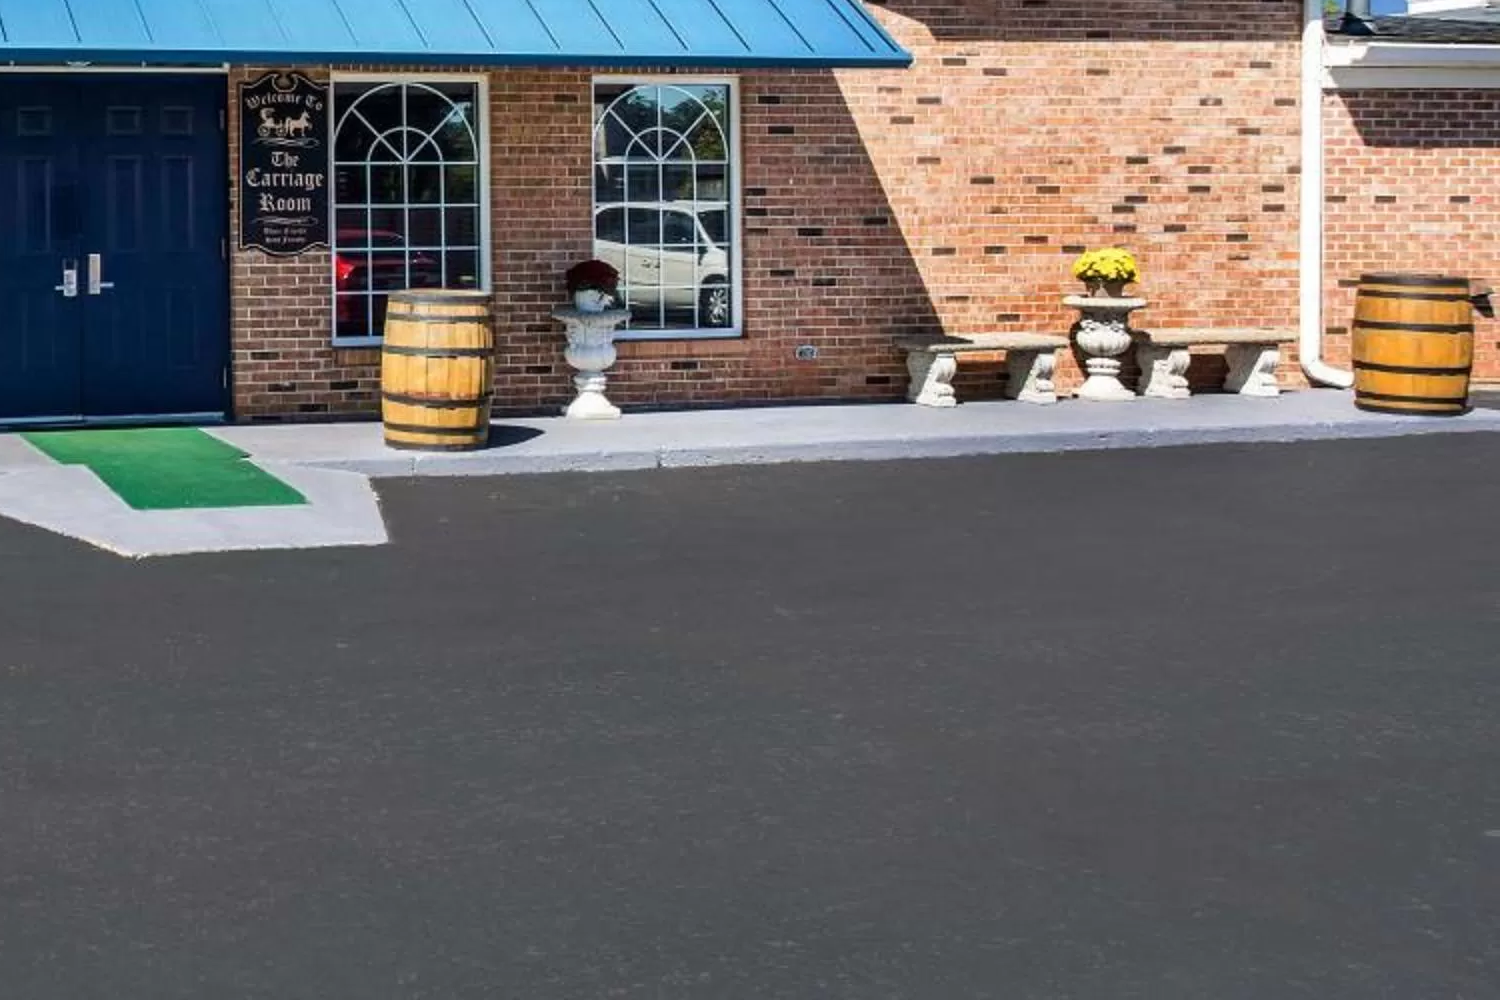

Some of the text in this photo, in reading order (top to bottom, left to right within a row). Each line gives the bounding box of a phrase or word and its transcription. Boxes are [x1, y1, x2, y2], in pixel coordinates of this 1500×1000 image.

[246, 93, 323, 111] Welcome To
[271, 151, 300, 167] The
[246, 168, 324, 190] Carriage
[259, 193, 311, 212] Room
